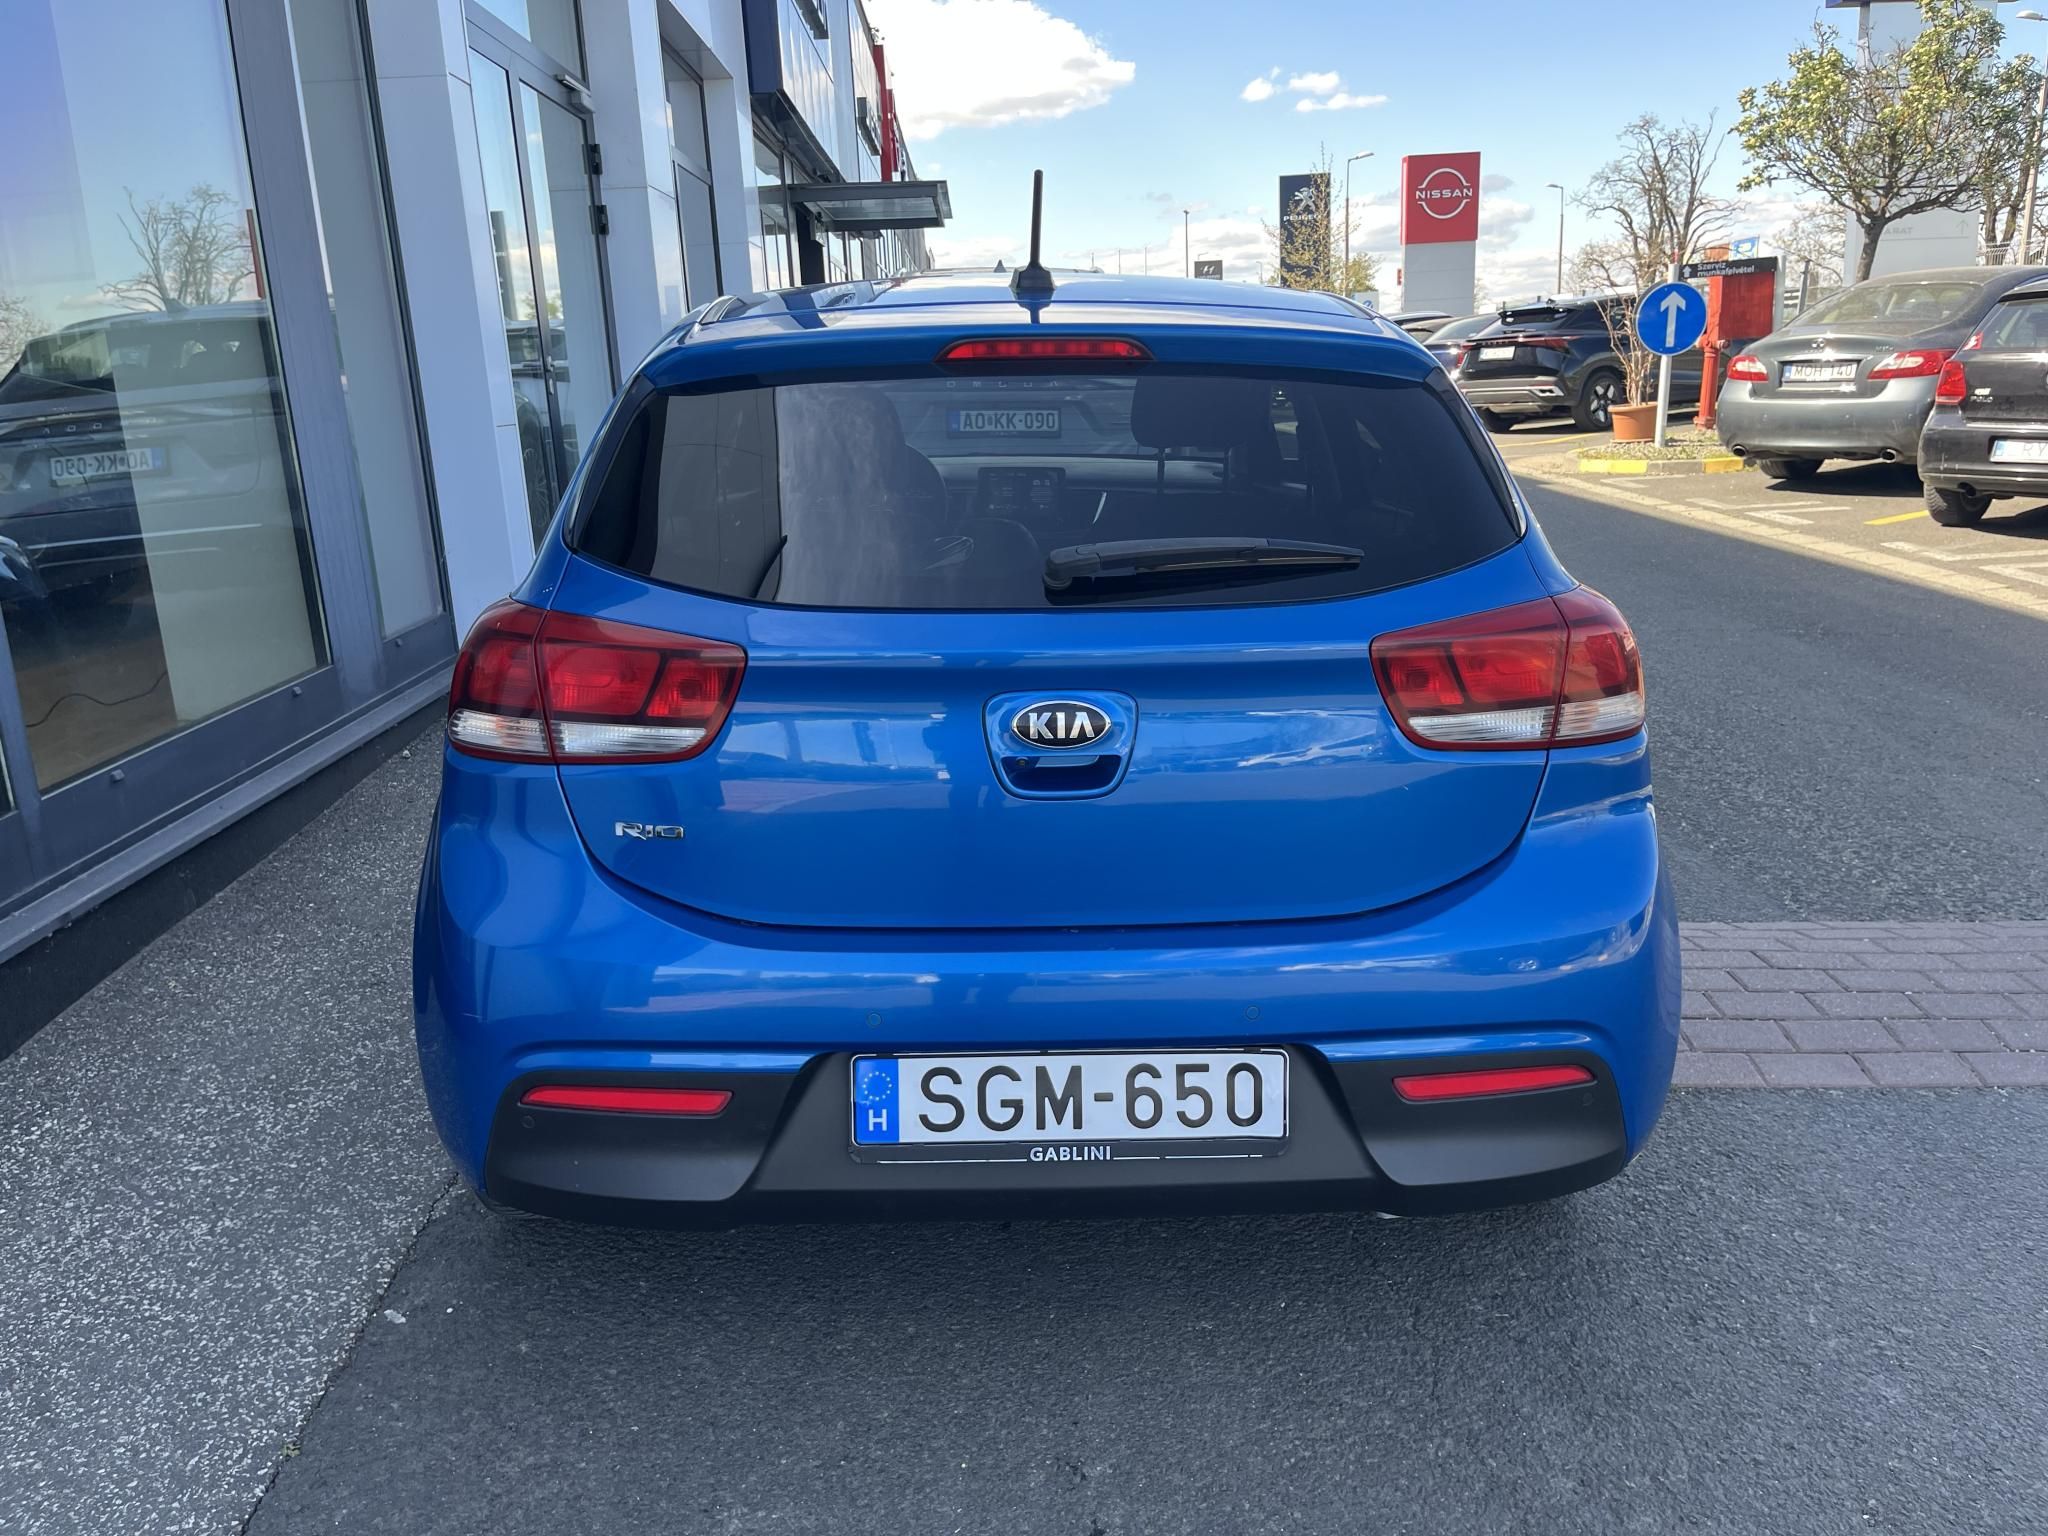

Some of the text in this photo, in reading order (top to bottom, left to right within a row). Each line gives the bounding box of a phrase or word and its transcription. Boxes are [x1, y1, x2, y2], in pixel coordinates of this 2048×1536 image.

[1415, 188, 1473, 199] NISSAN
[1697, 262, 1727, 271] Szerviz
[1028, 711, 1095, 739] KIA
[615, 822, 684, 840] RIO
[918, 1062, 1264, 1133] SGM-650
[868, 1109, 888, 1131] H
[1030, 1145, 1111, 1161] GABLINI
